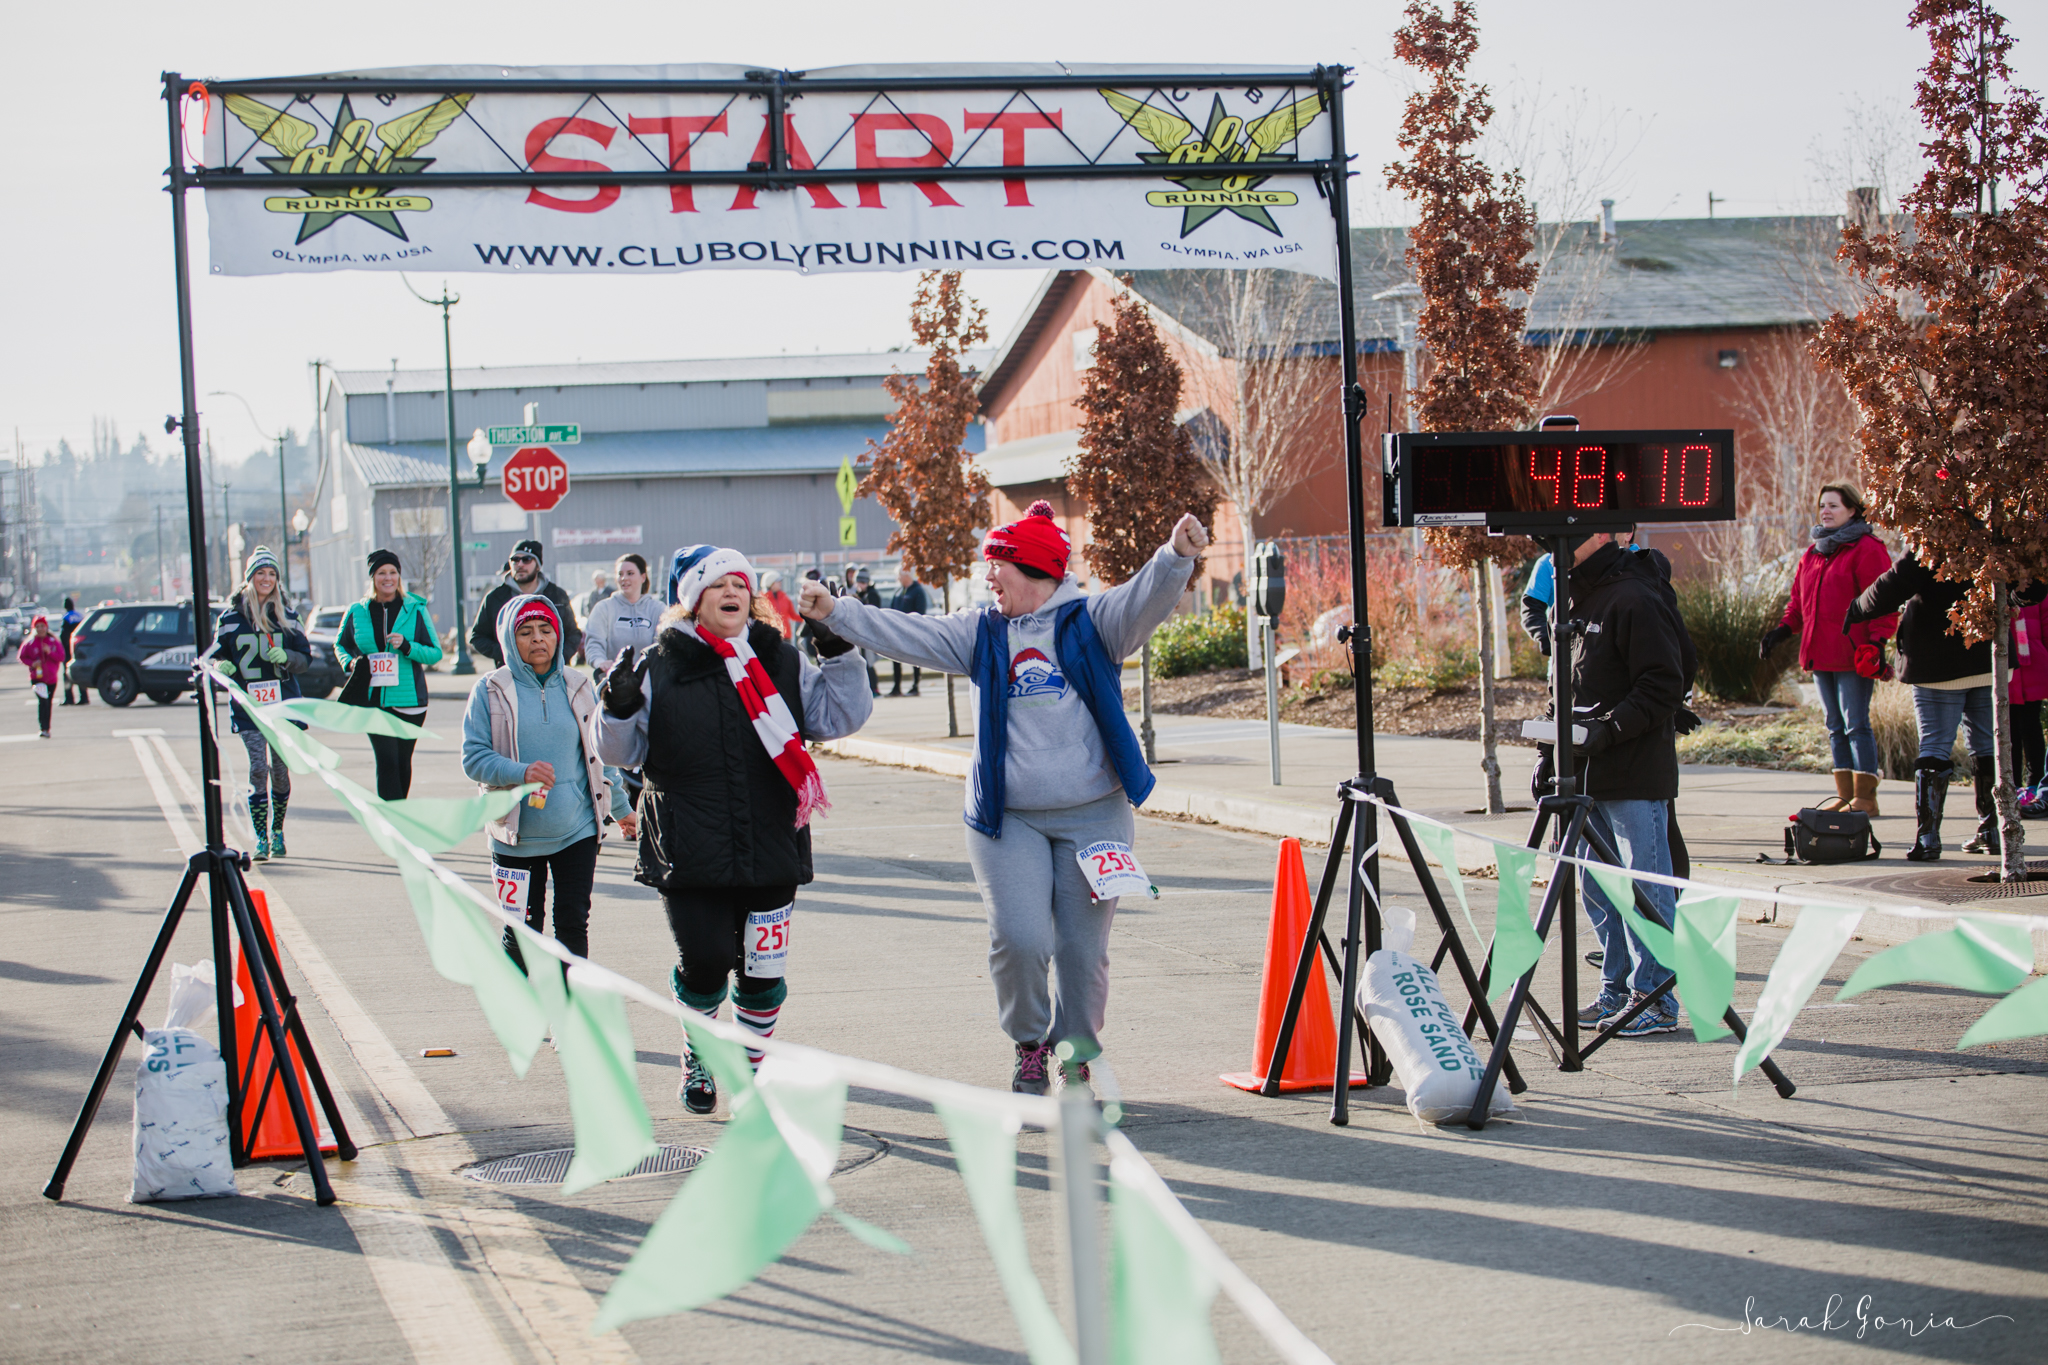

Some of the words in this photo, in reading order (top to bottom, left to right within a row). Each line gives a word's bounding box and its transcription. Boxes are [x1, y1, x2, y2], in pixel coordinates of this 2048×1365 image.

[525, 107, 1063, 213] START
[286, 198, 412, 210] RUNNING
[1165, 192, 1280, 204] RUNNING
[362, 253, 391, 263] WA
[396, 245, 433, 259] USA
[474, 238, 1126, 269] WWW.CLUBOLYRUNNING.COM
[1243, 247, 1269, 260] WA
[1274, 242, 1303, 255] USA
[490, 427, 546, 444] THURSTON
[507, 465, 565, 493] STOP
[235, 632, 284, 680] 24
[372, 659, 393, 673] 302
[254, 687, 276, 702] 324
[1079, 842, 1117, 861] REINDEER
[1091, 852, 1136, 876] 259
[510, 870, 526, 882] RUN
[748, 910, 784, 925] REINDEER
[756, 919, 790, 952] 257
[1392, 971, 1433, 1019] ROSE
[1419, 1023, 1462, 1072] SAND
[1411, 962, 1439, 994] ALL
[1431, 1000, 1487, 1081] PURPOSE
